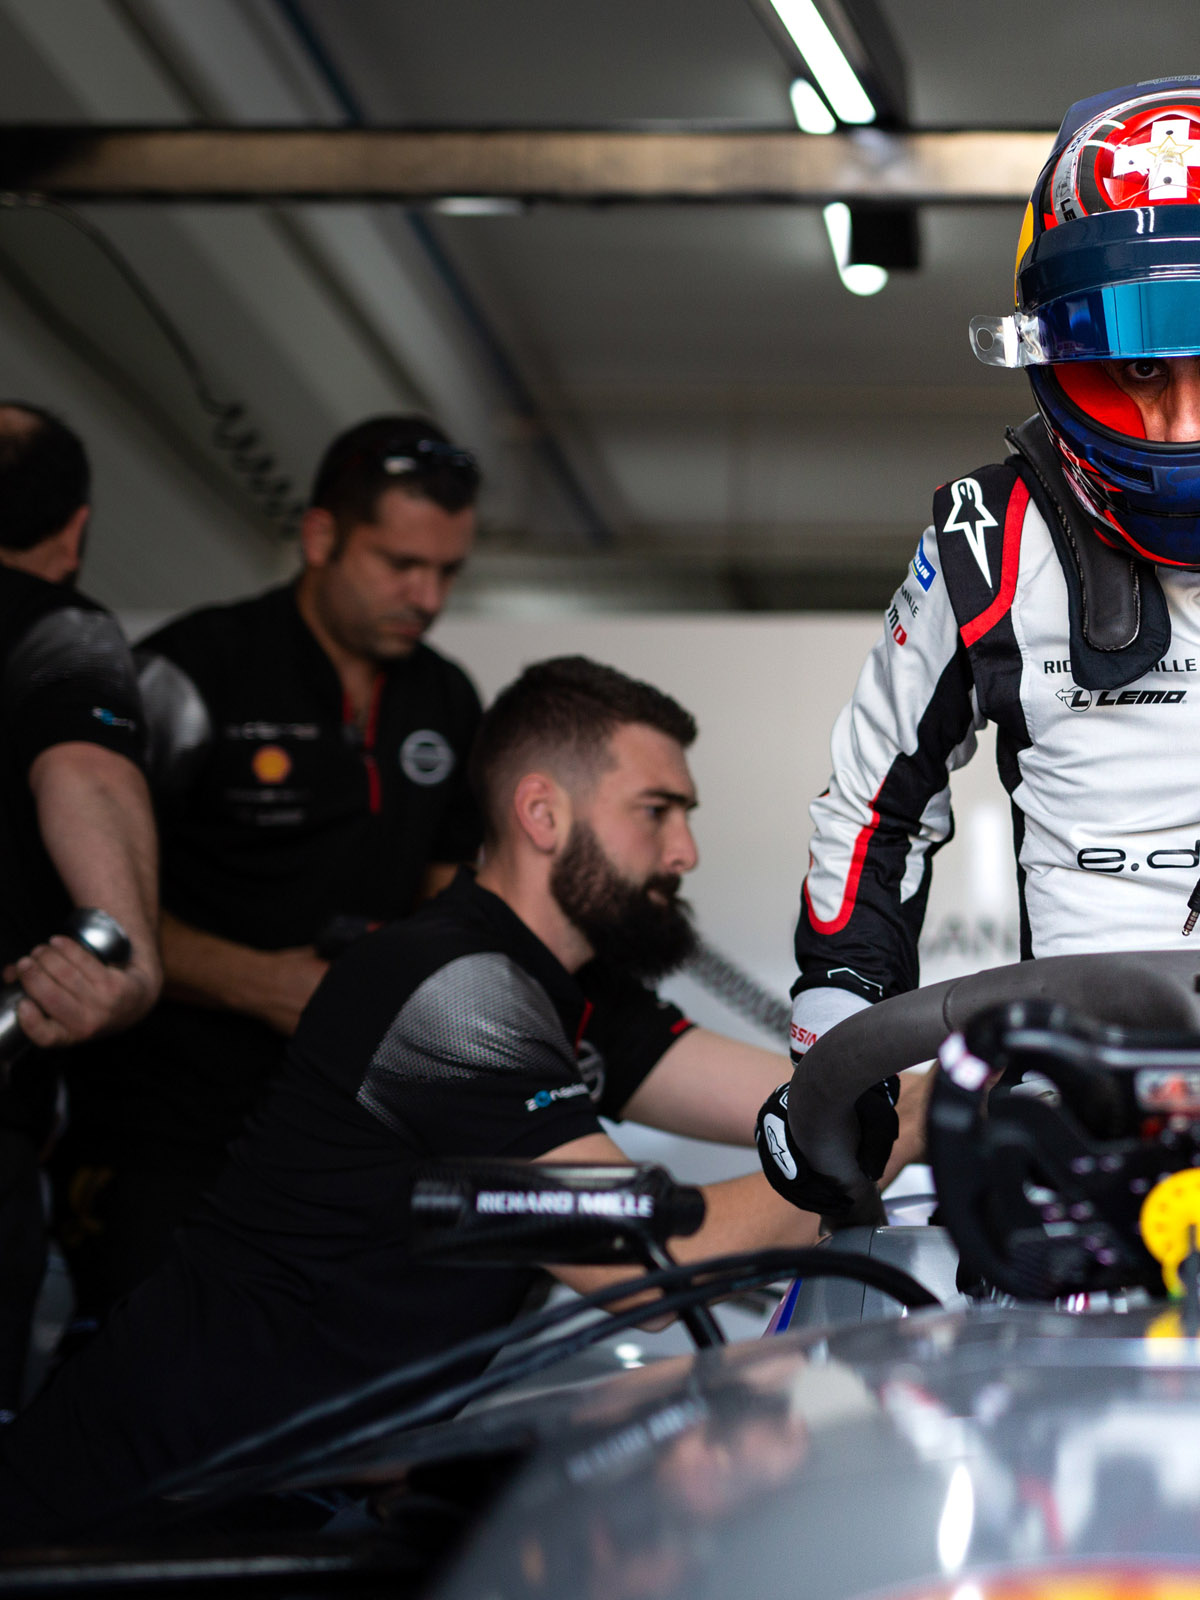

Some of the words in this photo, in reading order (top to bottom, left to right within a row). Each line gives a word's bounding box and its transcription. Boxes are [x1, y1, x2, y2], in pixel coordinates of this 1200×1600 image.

[1060, 198, 1077, 222] LE
[1096, 690, 1187, 706] LEMO
[476, 1190, 574, 1213] RICHARD
